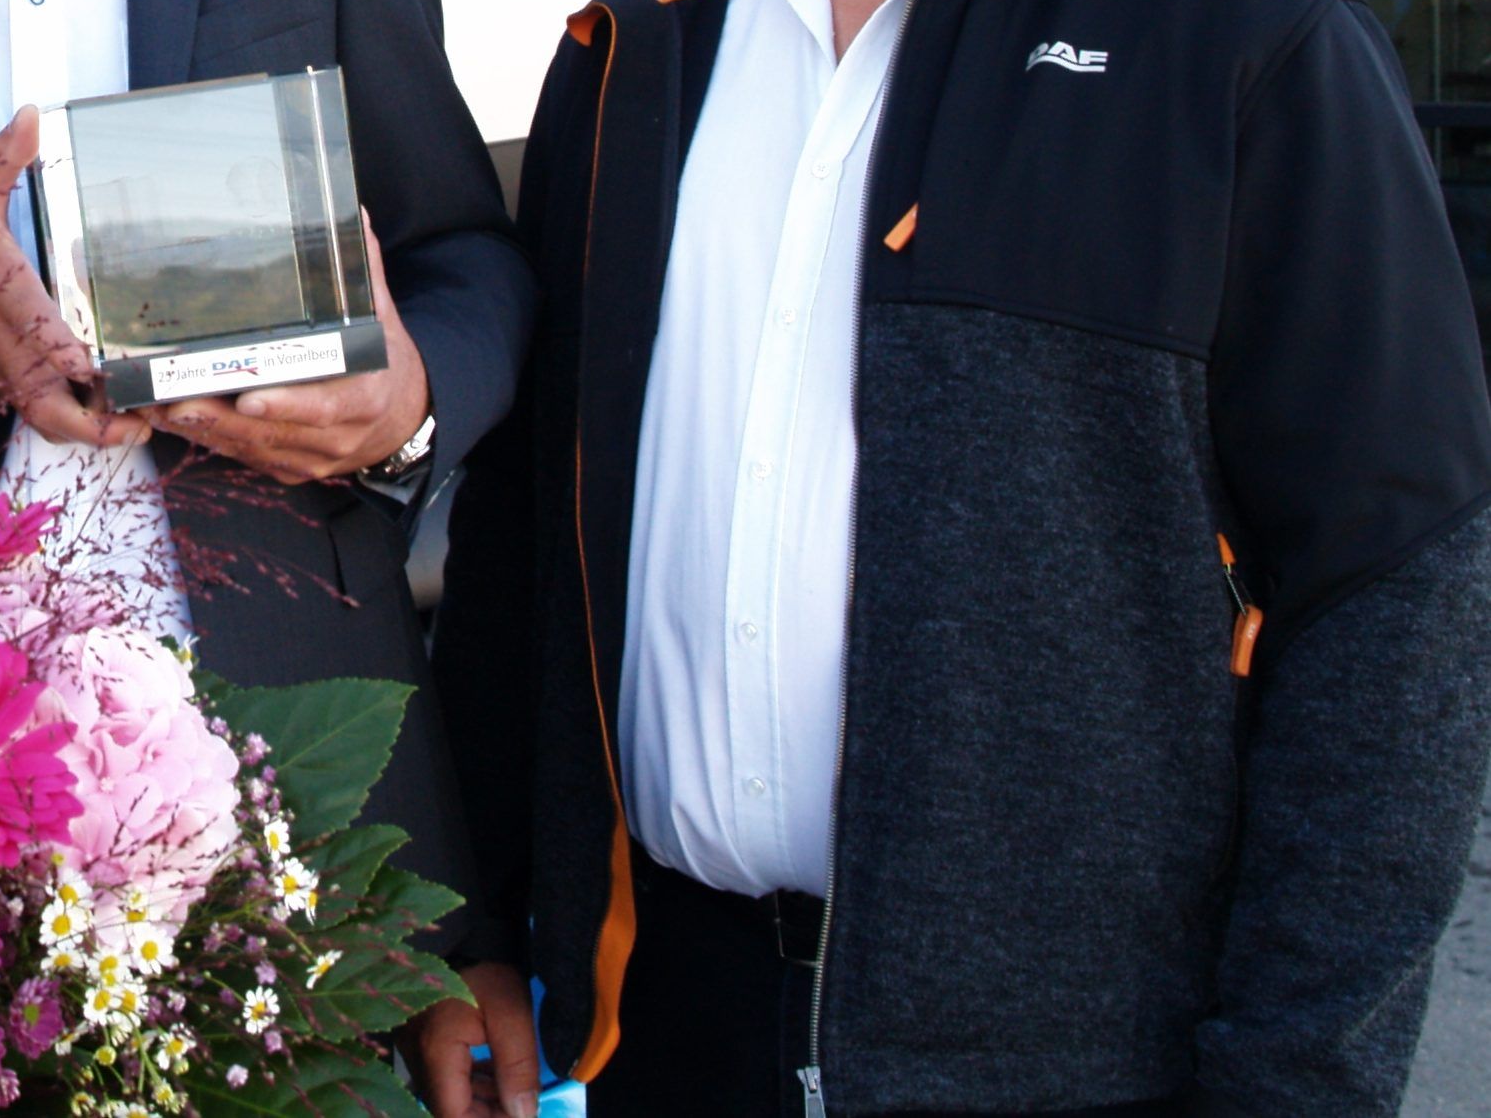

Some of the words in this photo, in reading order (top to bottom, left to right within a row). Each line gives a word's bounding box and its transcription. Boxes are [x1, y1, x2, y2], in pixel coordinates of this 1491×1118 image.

[175, 366, 207, 382] Jahre
[211, 356, 259, 373] DAF
[264, 354, 275, 367] in
[277, 347, 338, 365] Vorarlberg
